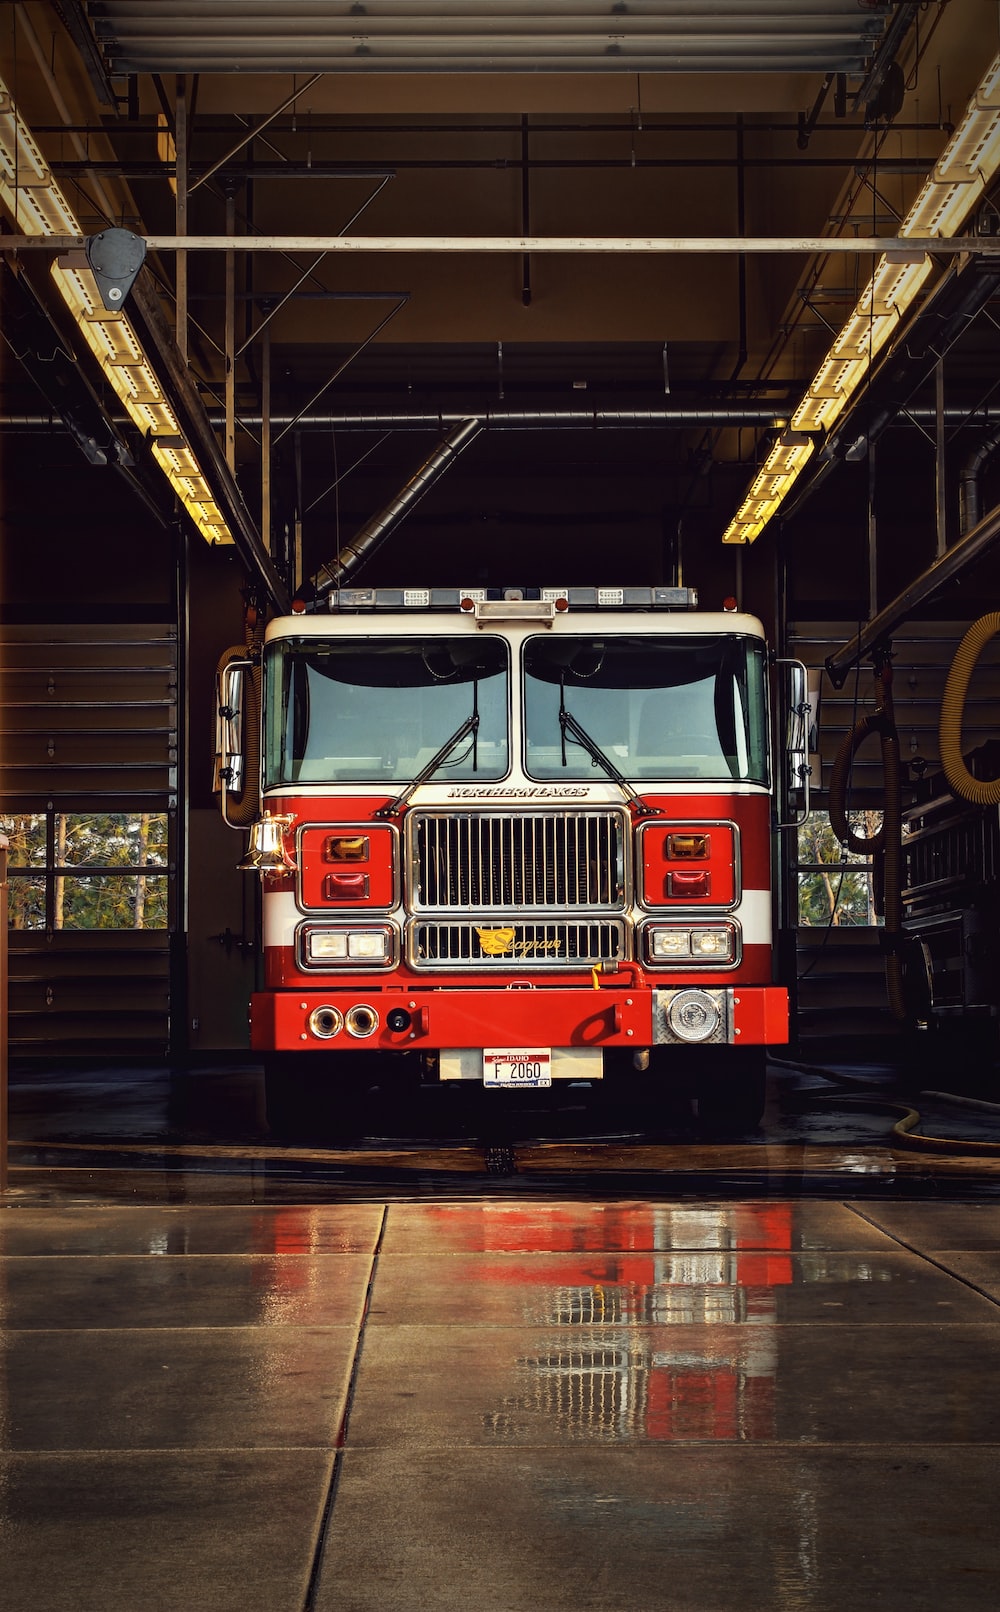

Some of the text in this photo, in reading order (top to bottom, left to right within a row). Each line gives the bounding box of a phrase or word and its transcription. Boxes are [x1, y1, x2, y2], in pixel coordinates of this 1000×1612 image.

[448, 787, 590, 798] NORTHERN LAKES
[495, 1062, 541, 1079] F 2060
